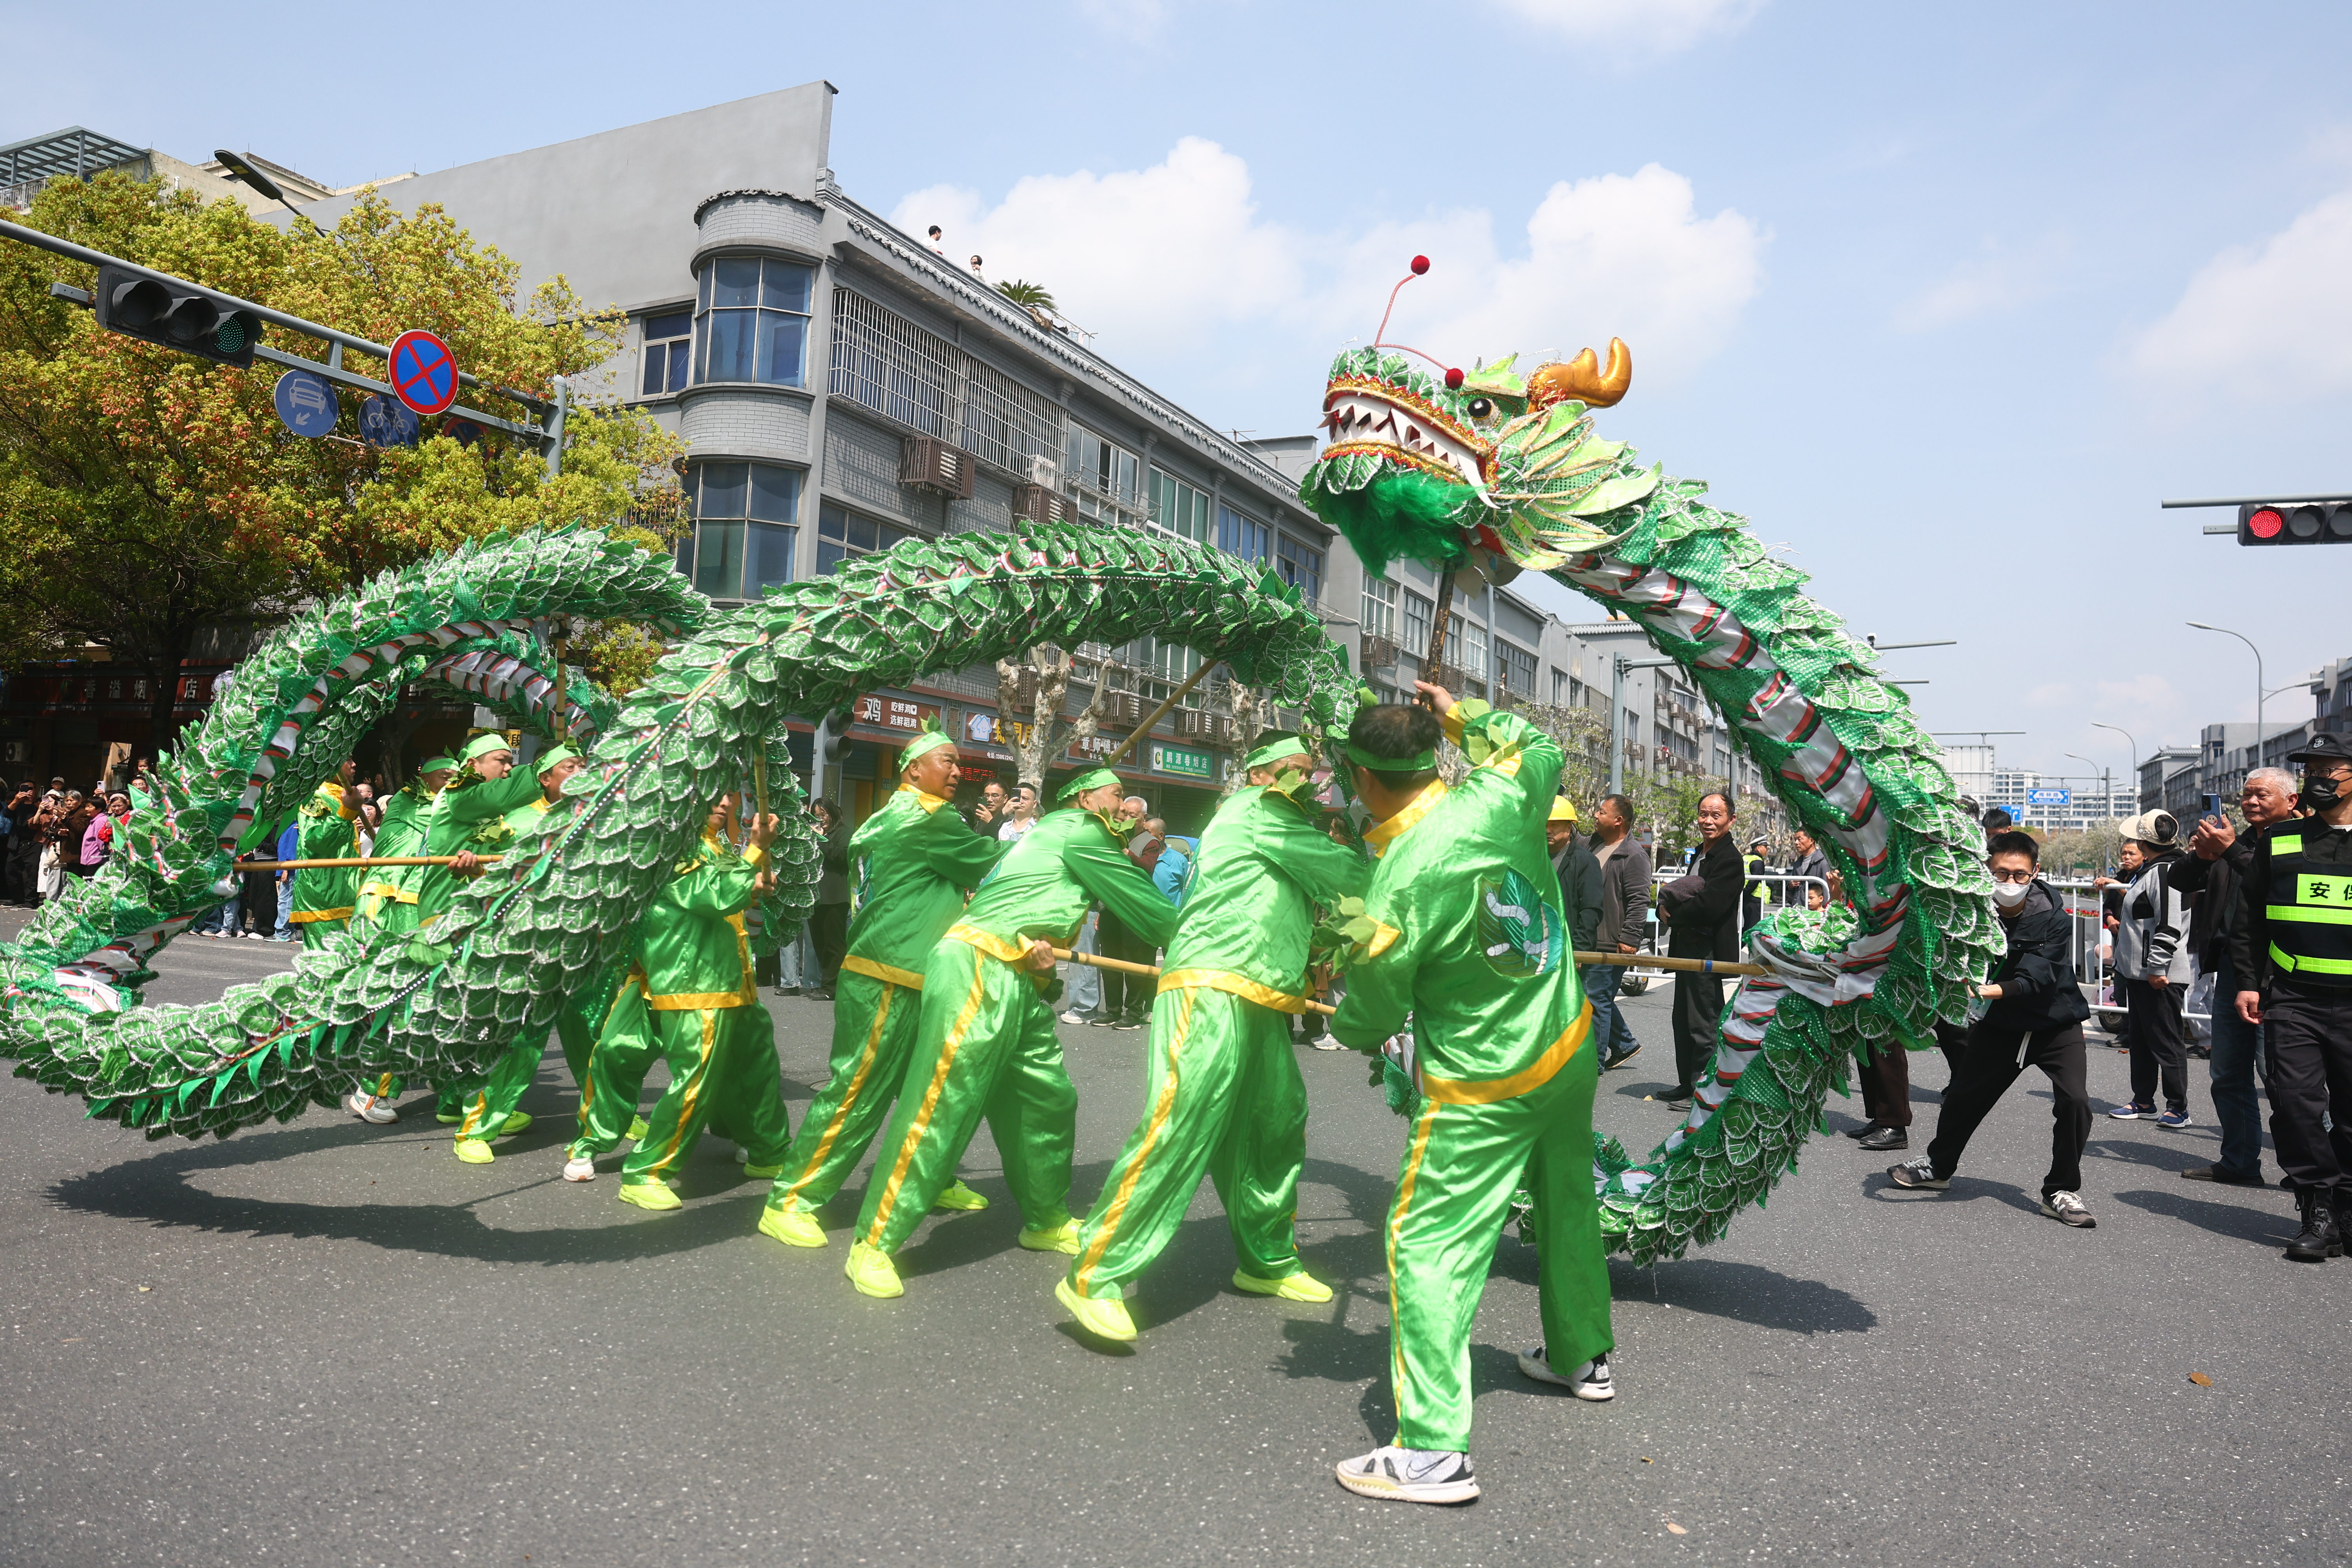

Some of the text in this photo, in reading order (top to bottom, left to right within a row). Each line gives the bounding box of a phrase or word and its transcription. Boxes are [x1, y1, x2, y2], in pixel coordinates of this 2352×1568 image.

[84, 679, 198, 699] 香溢烟店
[863, 698, 881, 722] 鸡
[891, 702, 911, 714] 吃鲜鸡
[987, 751, 1014, 762] 电话:13867242
[1166, 751, 1207, 769] 鹏源卷烟店
[1918, 1169, 1934, 1180] N
